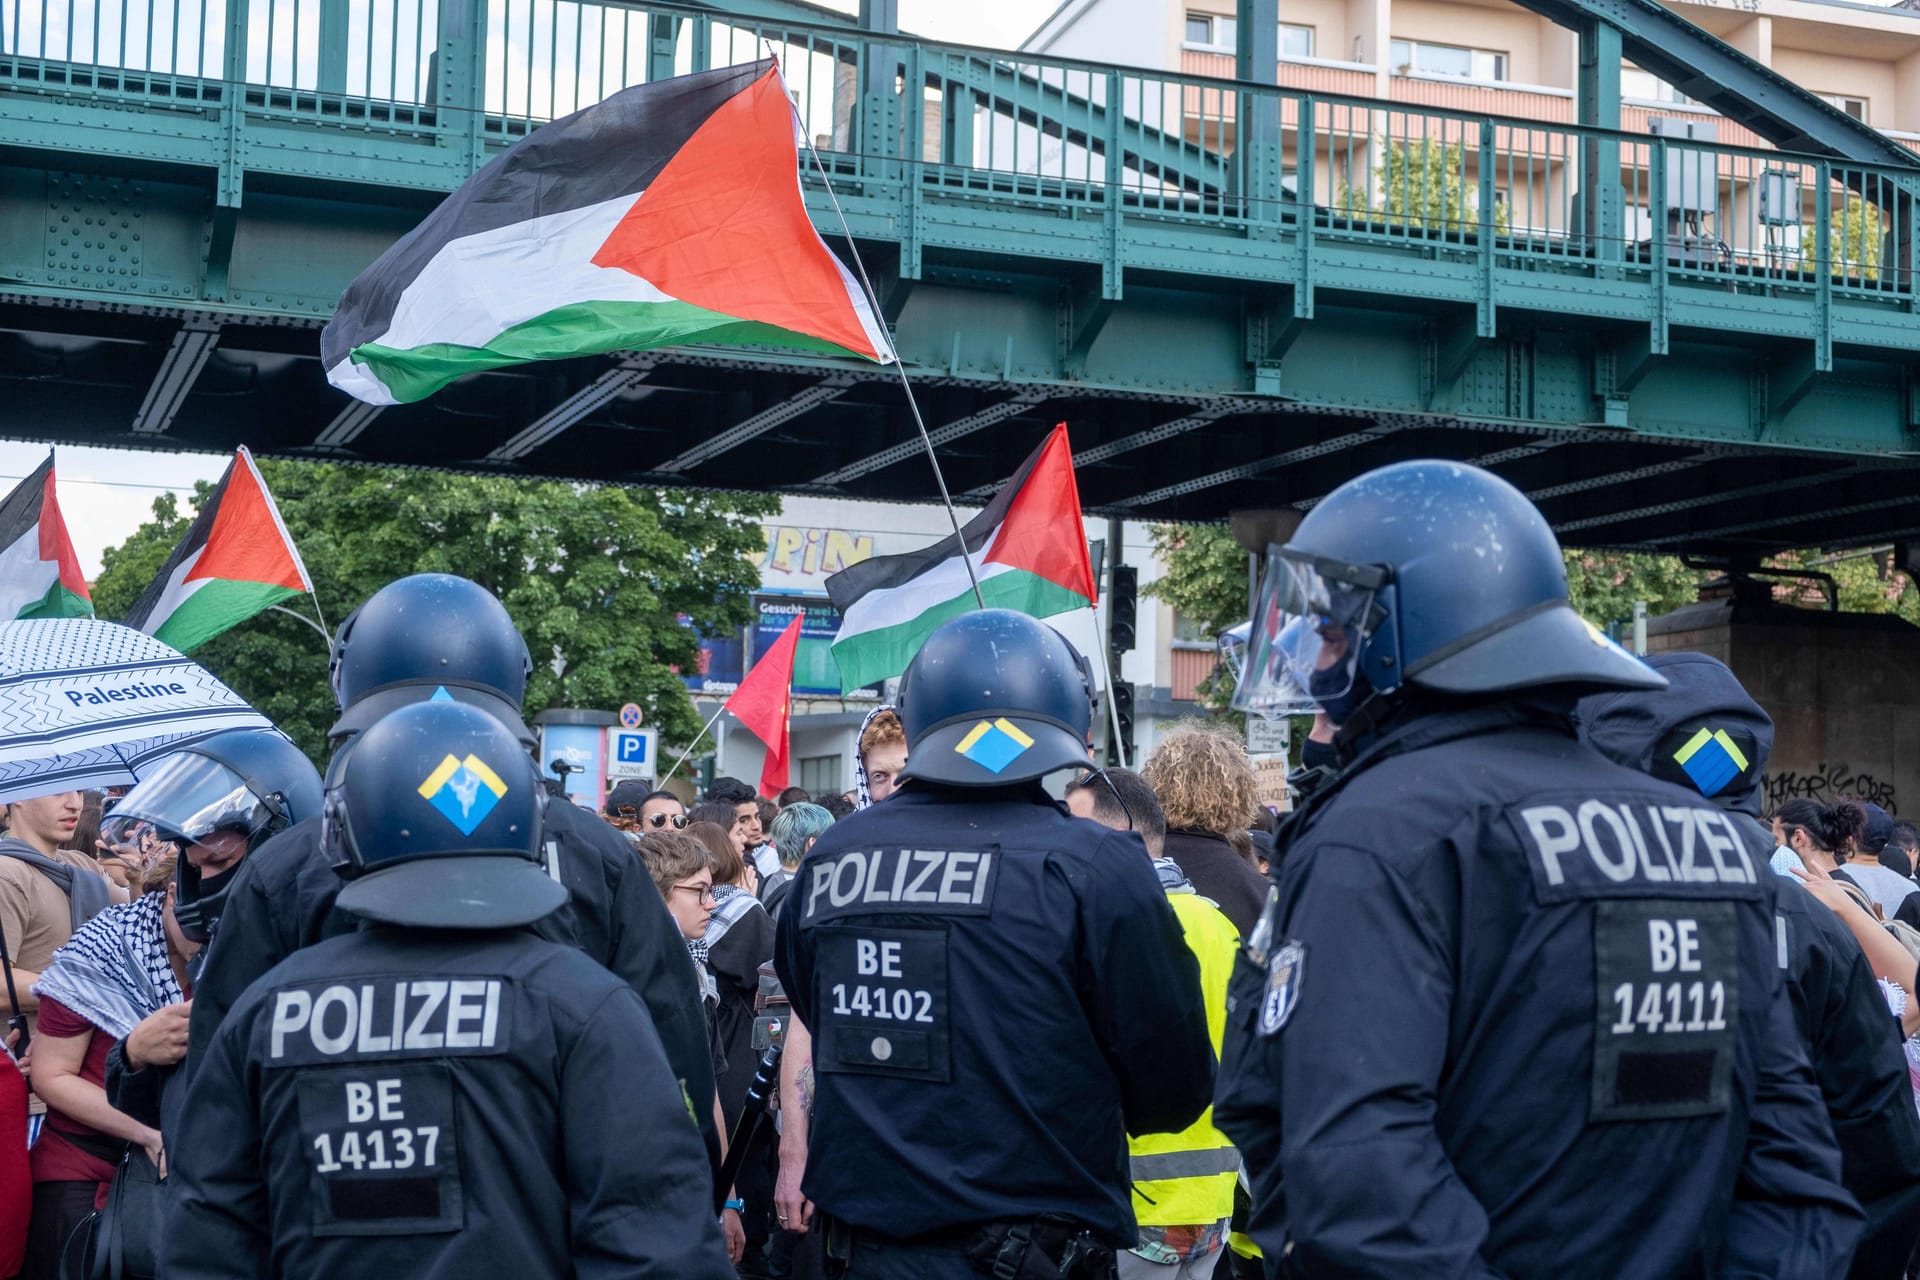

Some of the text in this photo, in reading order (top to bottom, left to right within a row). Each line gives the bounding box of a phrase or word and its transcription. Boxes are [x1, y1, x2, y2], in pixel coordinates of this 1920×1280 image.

[760, 602, 806, 615] Gesucht:
[807, 607, 831, 616] zwei
[64, 681, 187, 707] Palestine
[619, 765, 641, 775] ZONE
[623, 737, 640, 759] P
[1521, 799, 1757, 885] POLIZEI
[807, 850, 991, 918] POLIZEI
[857, 939, 902, 978] BE
[1649, 919, 1702, 972] BE
[271, 980, 501, 1058] POLIZEI
[832, 983, 934, 1023] 14102
[1612, 981, 1726, 1034] 14111
[346, 1079, 404, 1123] BE
[314, 1126, 440, 1173] 14137
